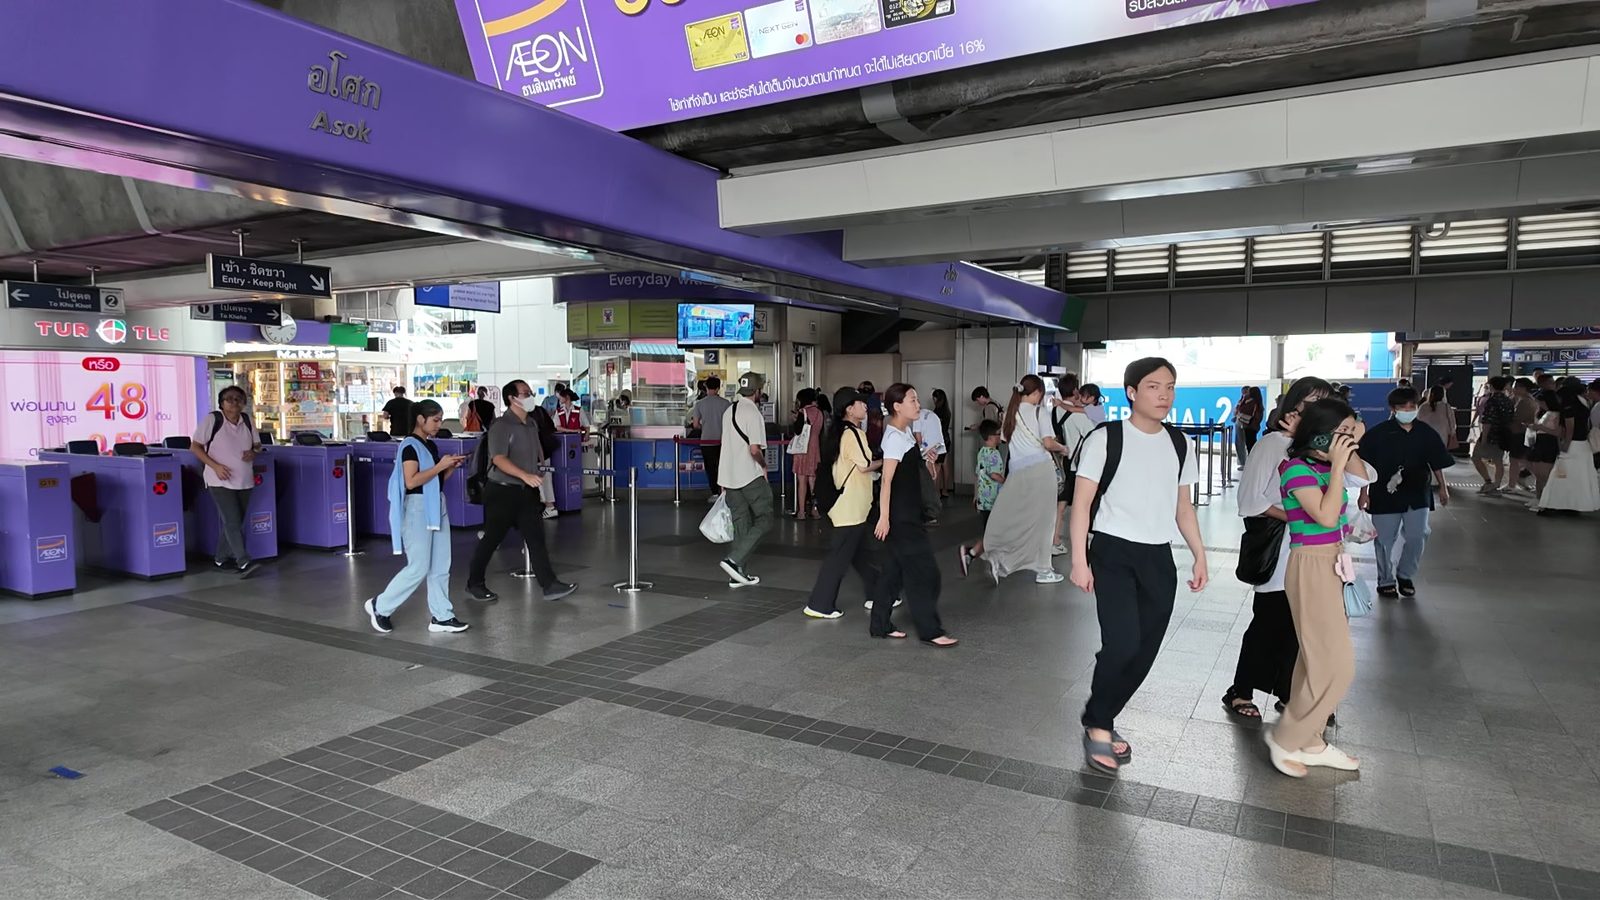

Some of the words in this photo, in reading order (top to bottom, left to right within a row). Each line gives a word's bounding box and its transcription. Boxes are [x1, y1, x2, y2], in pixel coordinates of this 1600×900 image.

[959, 38, 986, 55] 16%
[308, 50, 382, 110] อโศก
[521, 67, 577, 97] ธนสินทรัพย์
[309, 110, 372, 144] Asok
[221, 260, 240, 273] เข้า
[249, 262, 285, 278] ชิดขวา
[222, 275, 246, 286] Entry
[252, 278, 274, 289] Keep
[275, 280, 297, 291] Right
[608, 272, 672, 288] Everyday
[107, 296, 116, 306] 2
[34, 320, 91, 338] TUR
[132, 324, 170, 341] TLE
[88, 359, 114, 370] หรือ
[708, 352, 716, 362] 2
[10, 398, 76, 412] ผ่อนนาน
[85, 382, 149, 421] 48
[46, 414, 77, 426] สูงสุด
